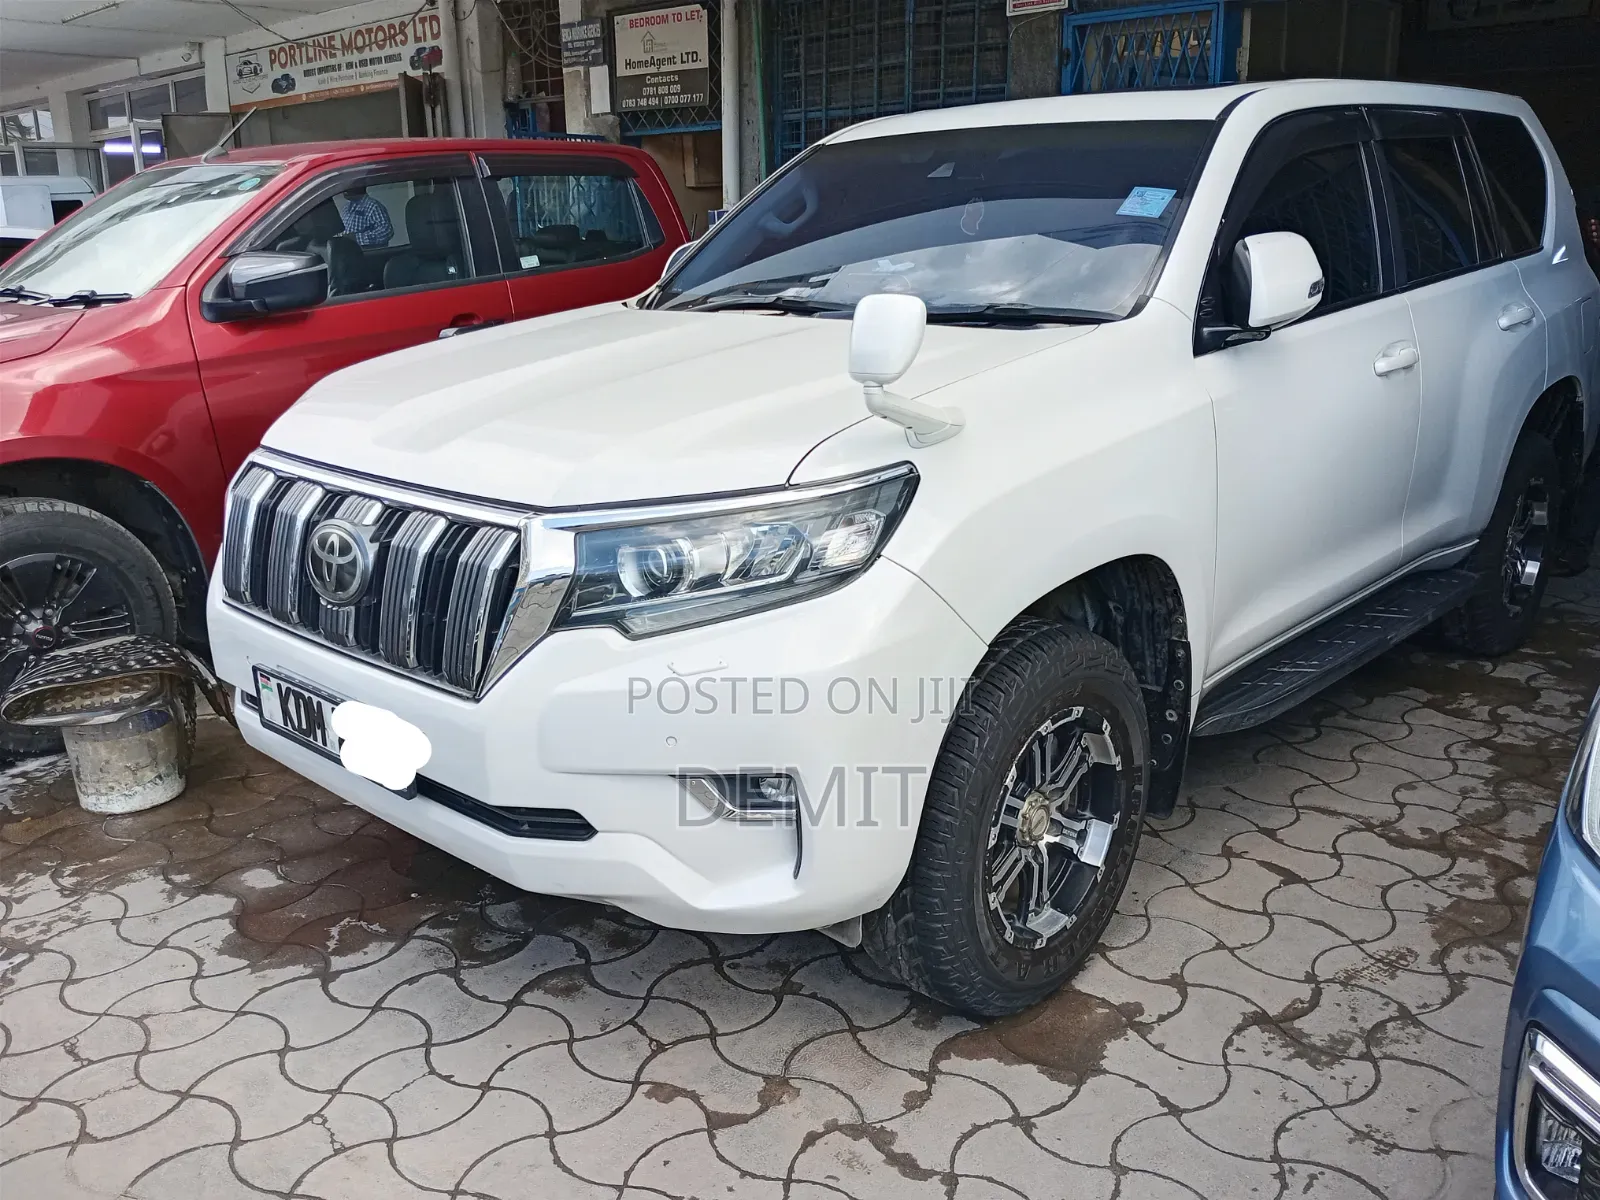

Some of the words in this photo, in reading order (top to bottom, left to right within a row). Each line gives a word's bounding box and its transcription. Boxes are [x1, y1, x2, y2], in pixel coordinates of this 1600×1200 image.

[629, 14, 669, 29] BEDROOM
[672, 12, 682, 23] TO
[269, 35, 337, 71] PORTLINE
[340, 20, 408, 57] MOTORS
[413, 14, 441, 44] LTD
[625, 53, 676, 71] HomeAgent
[681, 51, 701, 64] LTD.
[645, 74, 679, 84] Contacts
[680, 94, 691, 104] 077
[693, 93, 704, 102] 177
[276, 682, 327, 747] KDM
